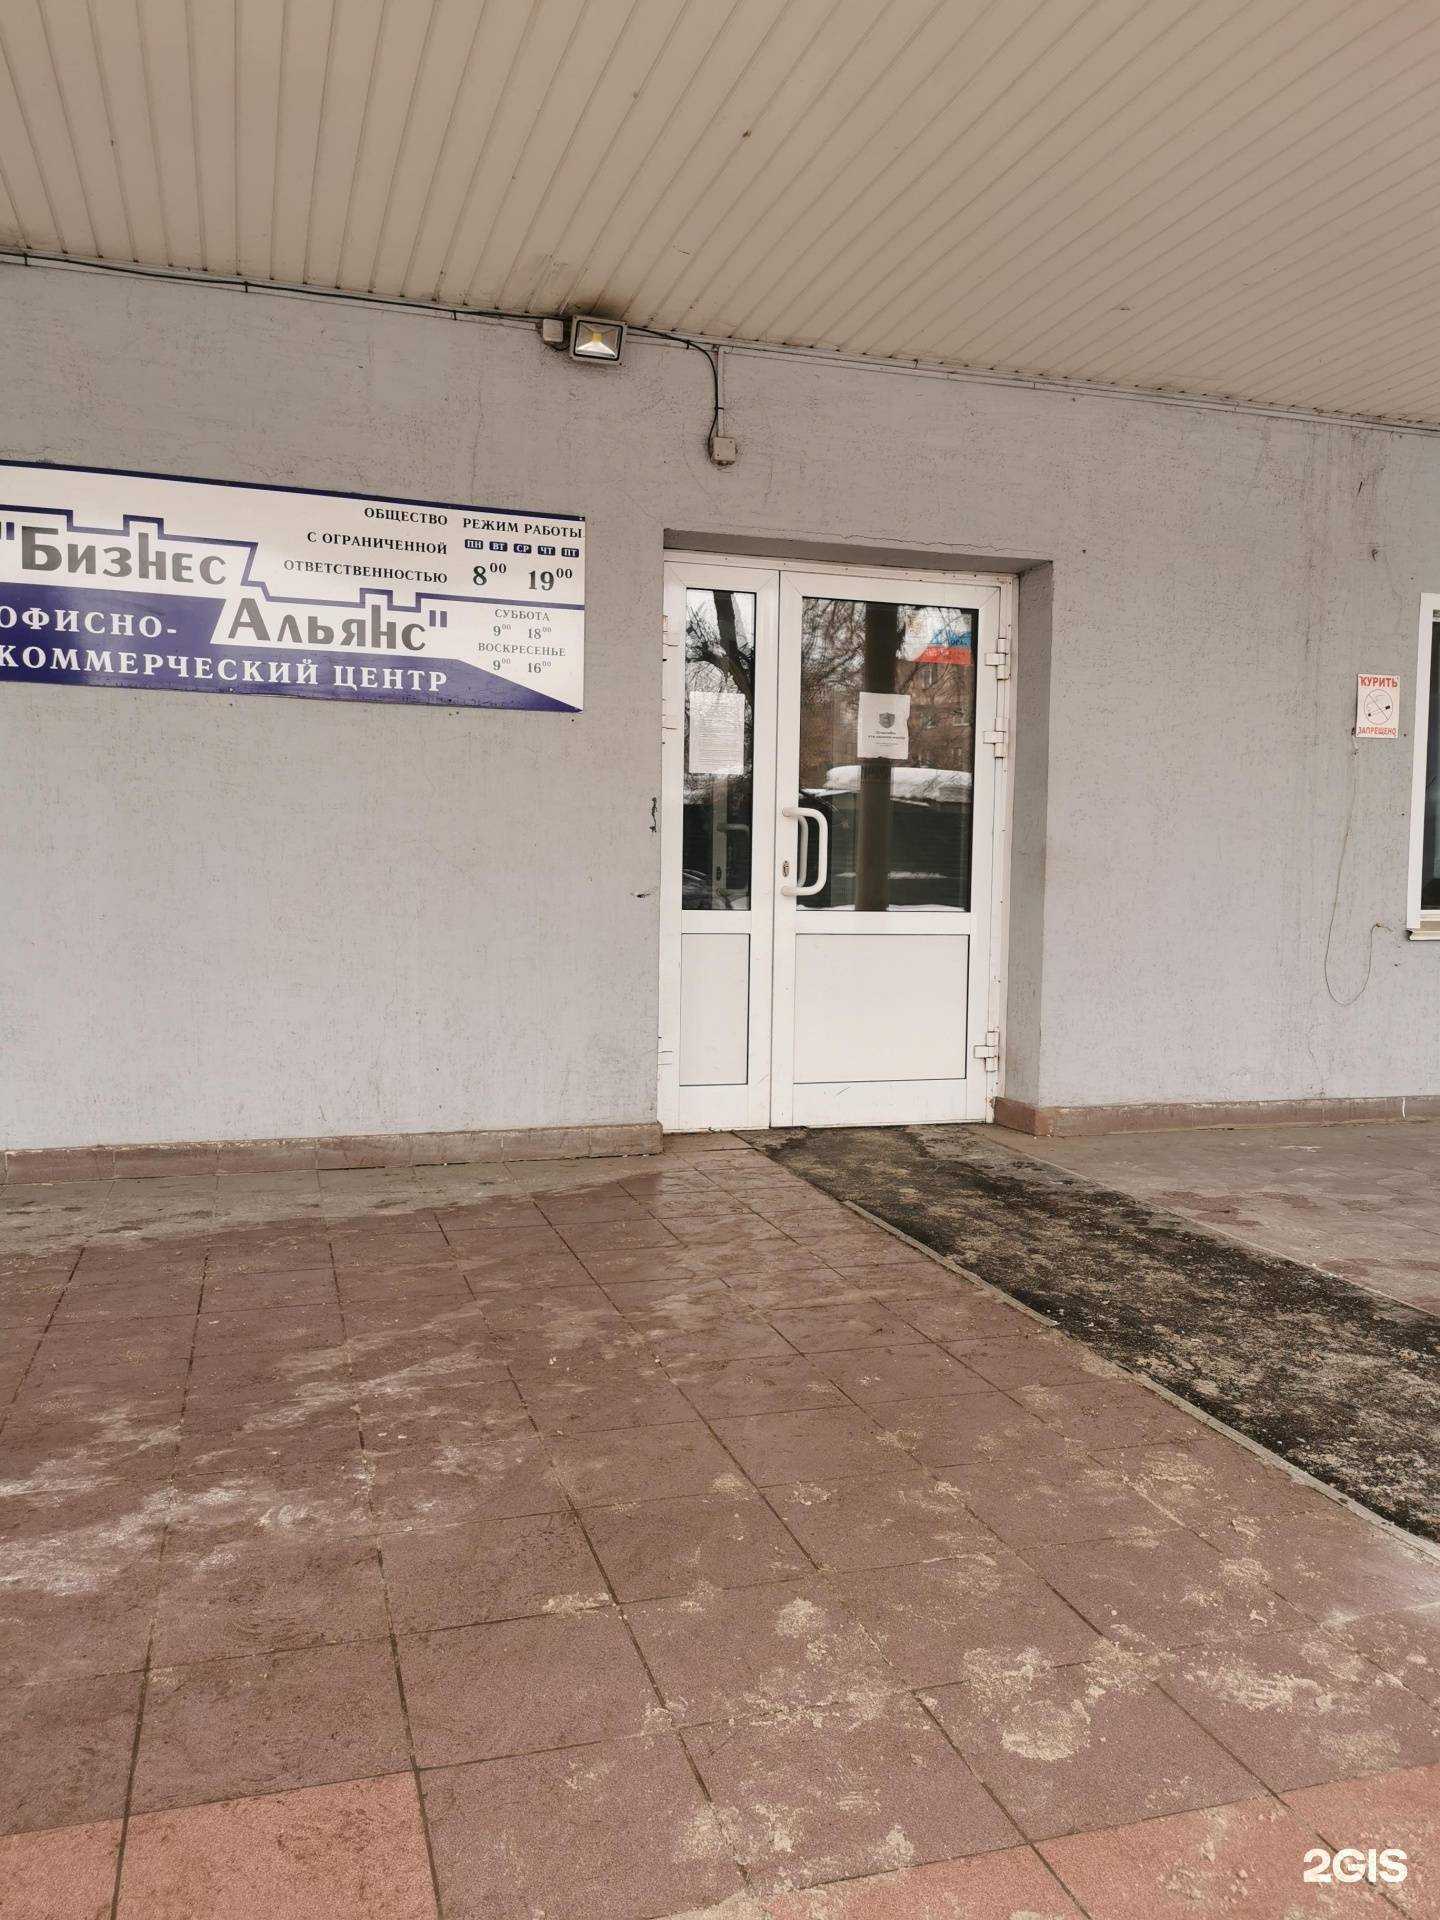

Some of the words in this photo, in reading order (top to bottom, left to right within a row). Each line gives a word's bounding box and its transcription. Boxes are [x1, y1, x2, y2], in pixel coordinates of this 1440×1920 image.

[364, 507, 448, 526] ОБЩЕСТВО
[463, 517, 519, 533] РЕЖИМ
[524, 523, 583, 539] РАБОТЫ
[307, 531, 317, 543] С
[322, 533, 448, 555] ОГРАНИЧЕННОЙ
[515, 544, 530, 553] СР
[283, 559, 448, 584] ОТВЕТСТВЕННОСТЬЮ
[0, 605, 177, 638] ОФИСНО-
[494, 608, 551, 621] СУББОТА
[478, 642, 567, 657] ВОСКРЕСЕНЬЕ
[0, 644, 319, 685] КОММЕРЧЕСКИЙ
[333, 664, 448, 692] ЦЕНТР
[1360, 676, 1398, 688] КУРИТЬ
[1358, 726, 1397, 735] ЗАПРЕЩЕНО
